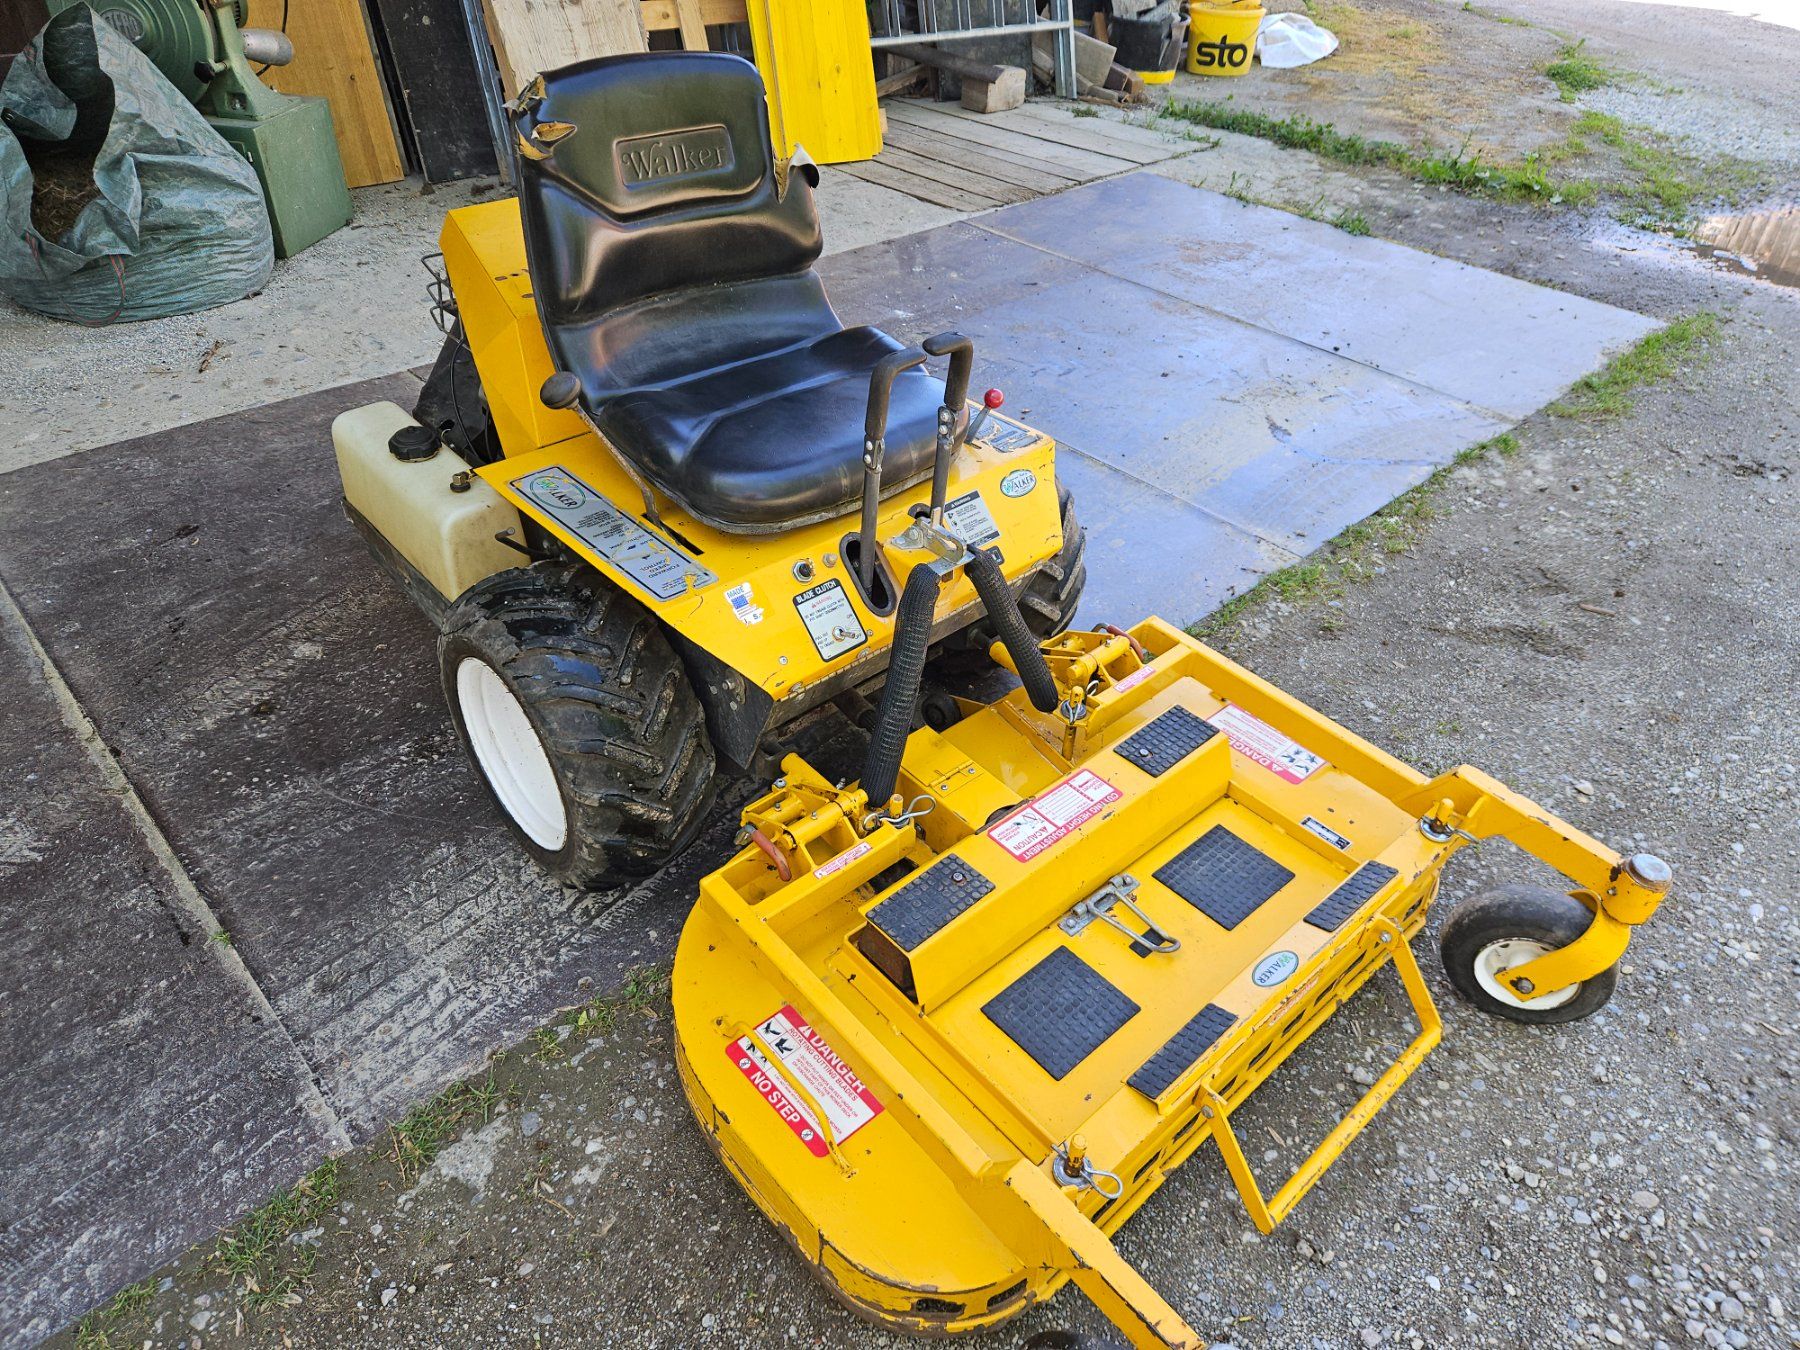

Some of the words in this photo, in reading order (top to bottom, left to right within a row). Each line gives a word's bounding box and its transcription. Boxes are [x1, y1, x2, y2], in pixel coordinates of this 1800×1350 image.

[1196, 34, 1247, 67] sto
[622, 142, 725, 180] Walker
[1004, 474, 1034, 493] WALKER
[727, 585, 744, 598] MADE
[795, 589, 815, 604] BLADE
[814, 579, 837, 595] CLUTCH
[1225, 736, 1272, 768] DANGE
[1065, 810, 1092, 830] HEIGHT
[1011, 829, 1043, 852] CAUTION
[1020, 825, 1069, 860] ADJUSTMENT
[1256, 953, 1294, 984] WALKER
[787, 1027, 815, 1055] ROTATING
[811, 1052, 837, 1079] CUTTING
[834, 1077, 858, 1102] BLADES
[808, 1034, 867, 1094] DANGER
[749, 1069, 773, 1094] NO
[766, 1089, 802, 1127] STEP
